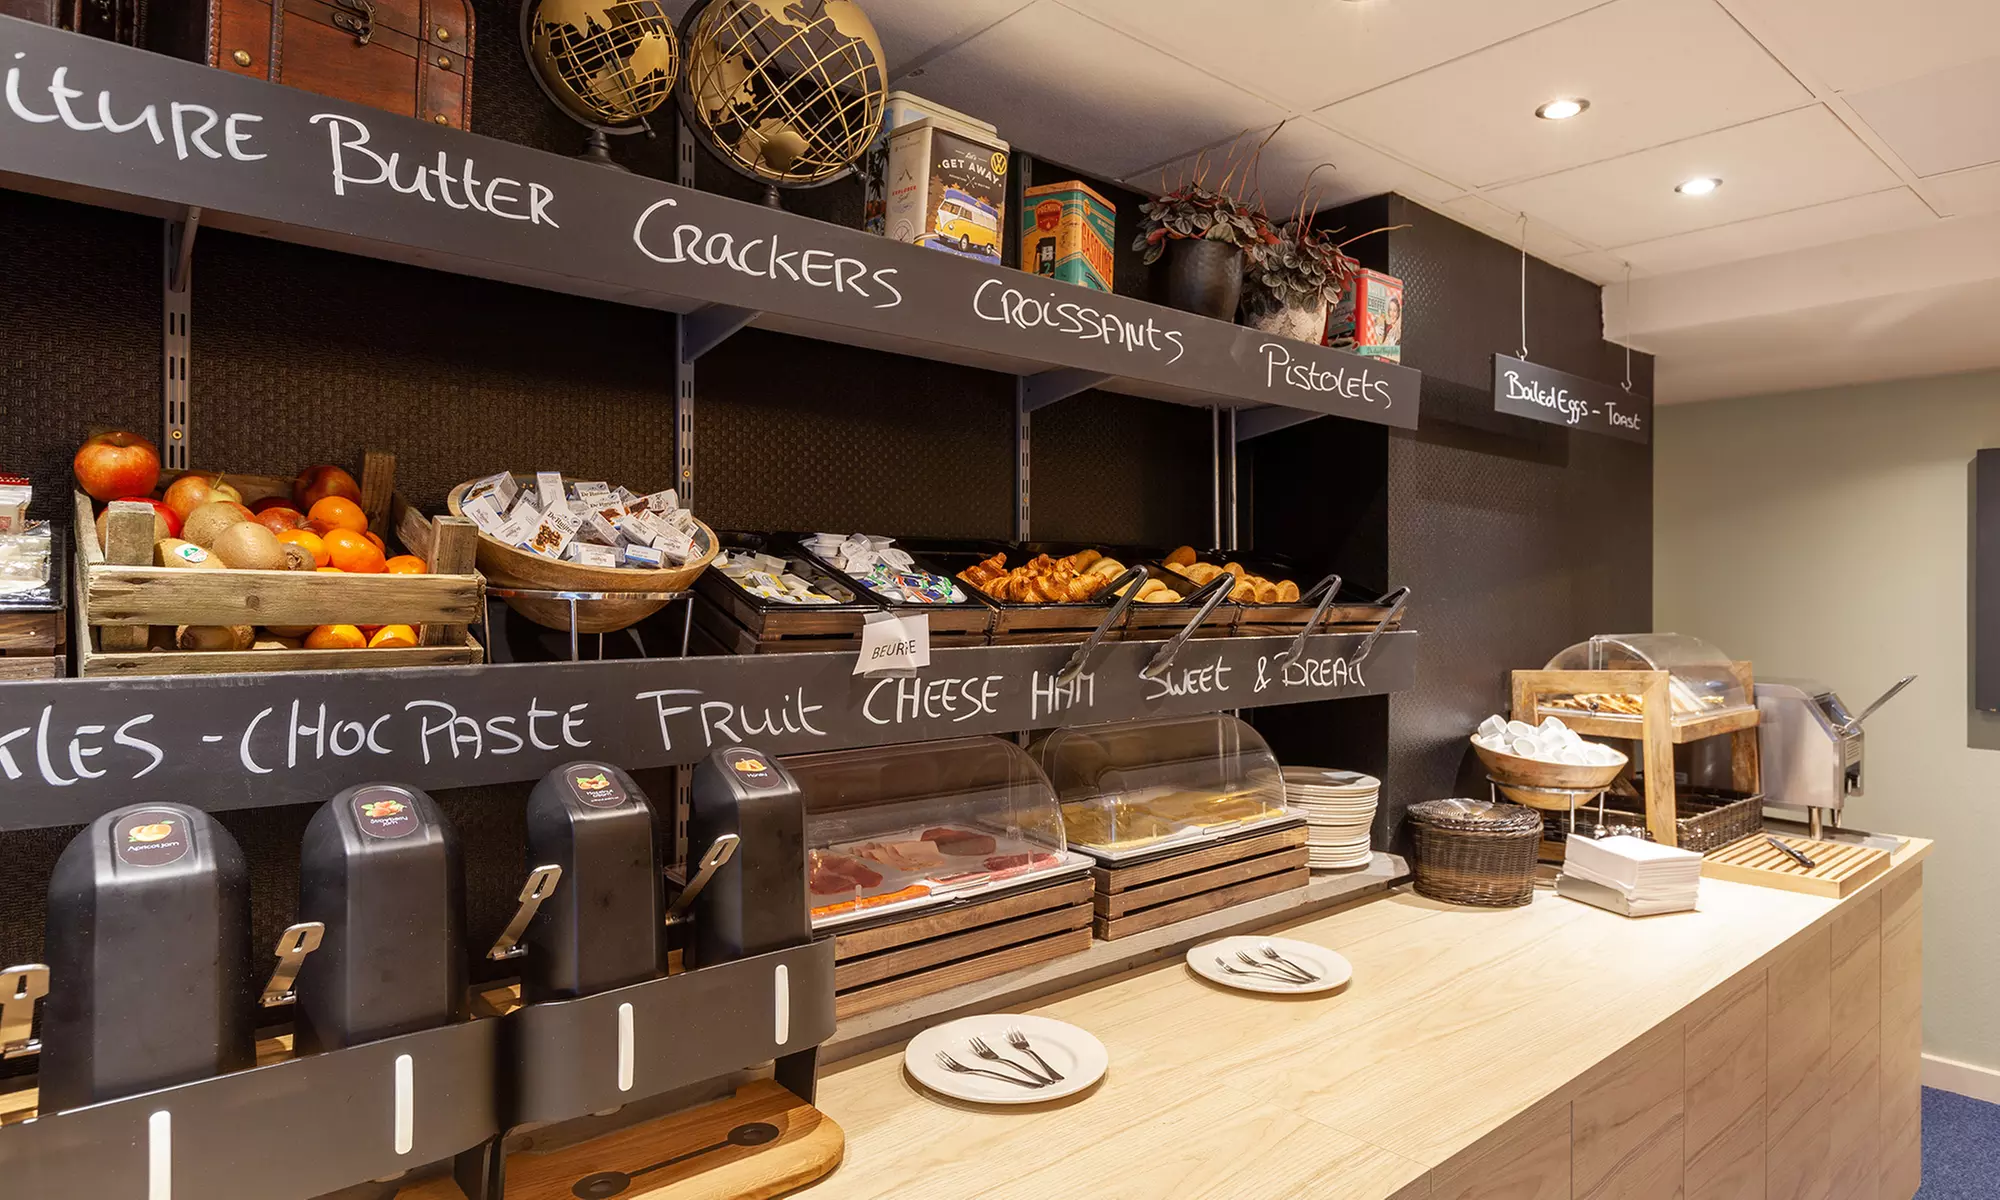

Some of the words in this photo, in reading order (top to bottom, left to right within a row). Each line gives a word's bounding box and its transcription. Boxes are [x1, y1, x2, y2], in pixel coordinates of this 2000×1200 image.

[942, 159, 964, 169] GET
[969, 162, 1000, 185] AWAY
[547, 511, 556, 521] De
[554, 517, 575, 535] Ruijter
[863, 674, 1003, 725] CHEESE
[1253, 656, 1272, 693] &
[127, 844, 160, 852] Apricot
